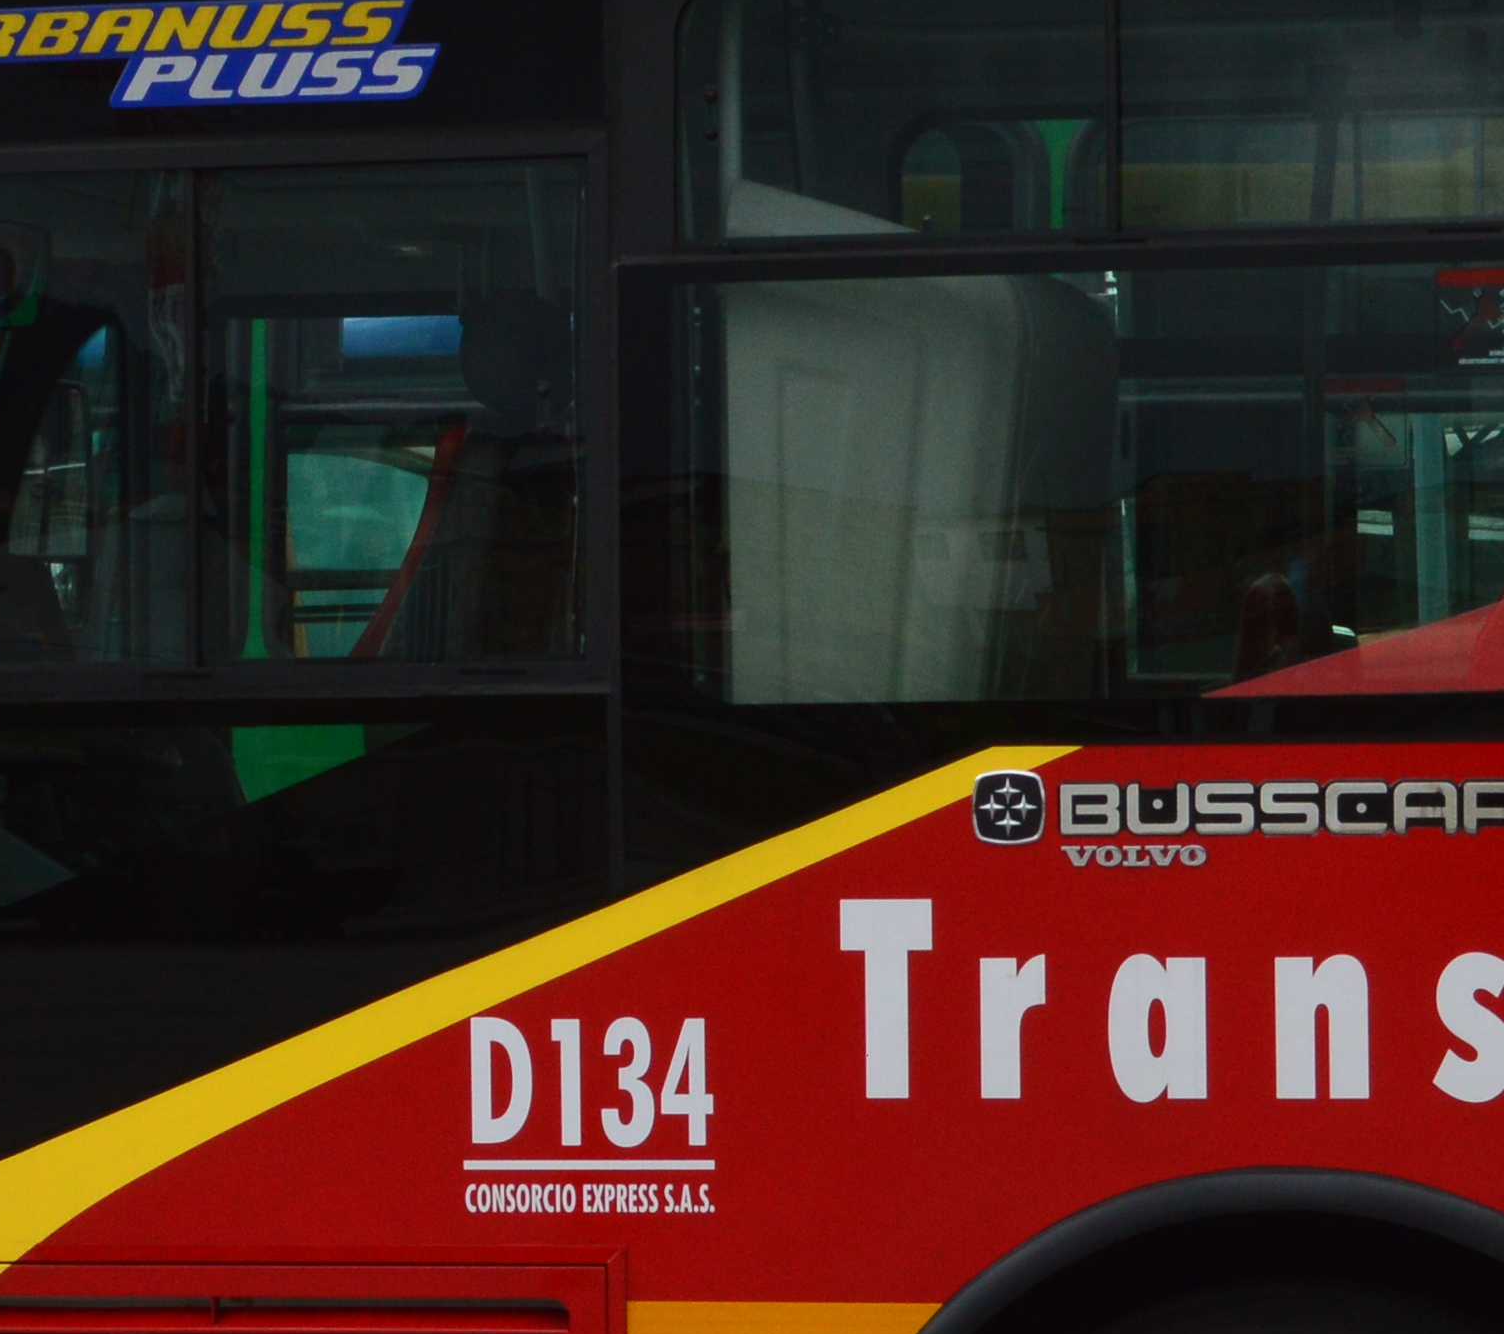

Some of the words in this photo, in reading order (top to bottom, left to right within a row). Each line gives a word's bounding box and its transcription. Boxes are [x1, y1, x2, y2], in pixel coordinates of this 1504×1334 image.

[121, 48, 436, 102] PLUSS
[1061, 845, 1207, 867] VOLVO
[471, 1016, 714, 1148] D134
[465, 1183, 577, 1213] CONSORCIO
[582, 1183, 659, 1213] EXPRESS
[664, 1183, 716, 1214] S.A.S.
